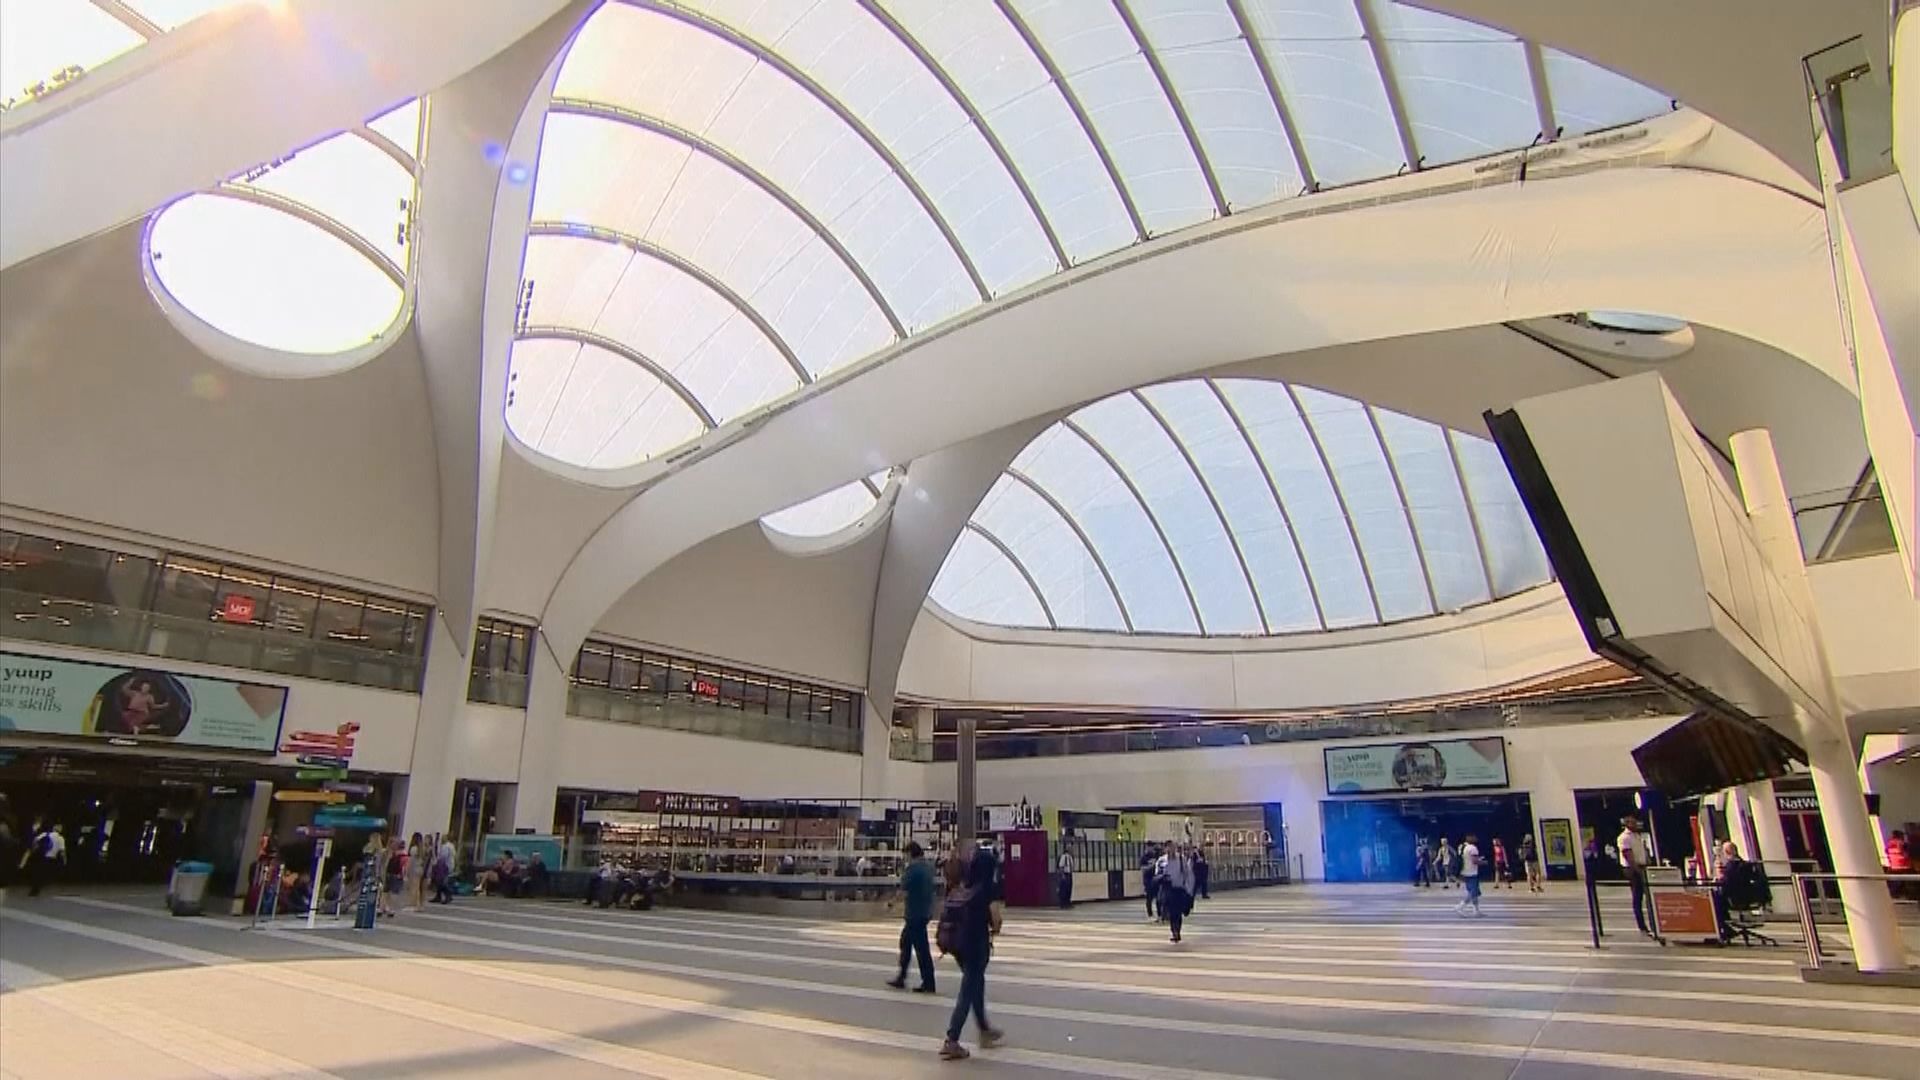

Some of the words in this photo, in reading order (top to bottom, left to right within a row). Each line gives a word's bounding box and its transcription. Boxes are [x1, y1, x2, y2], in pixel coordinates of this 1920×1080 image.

[4, 668, 52, 681] yuup
[698, 682, 719, 696] Pho
[17, 696, 62, 712] skills
